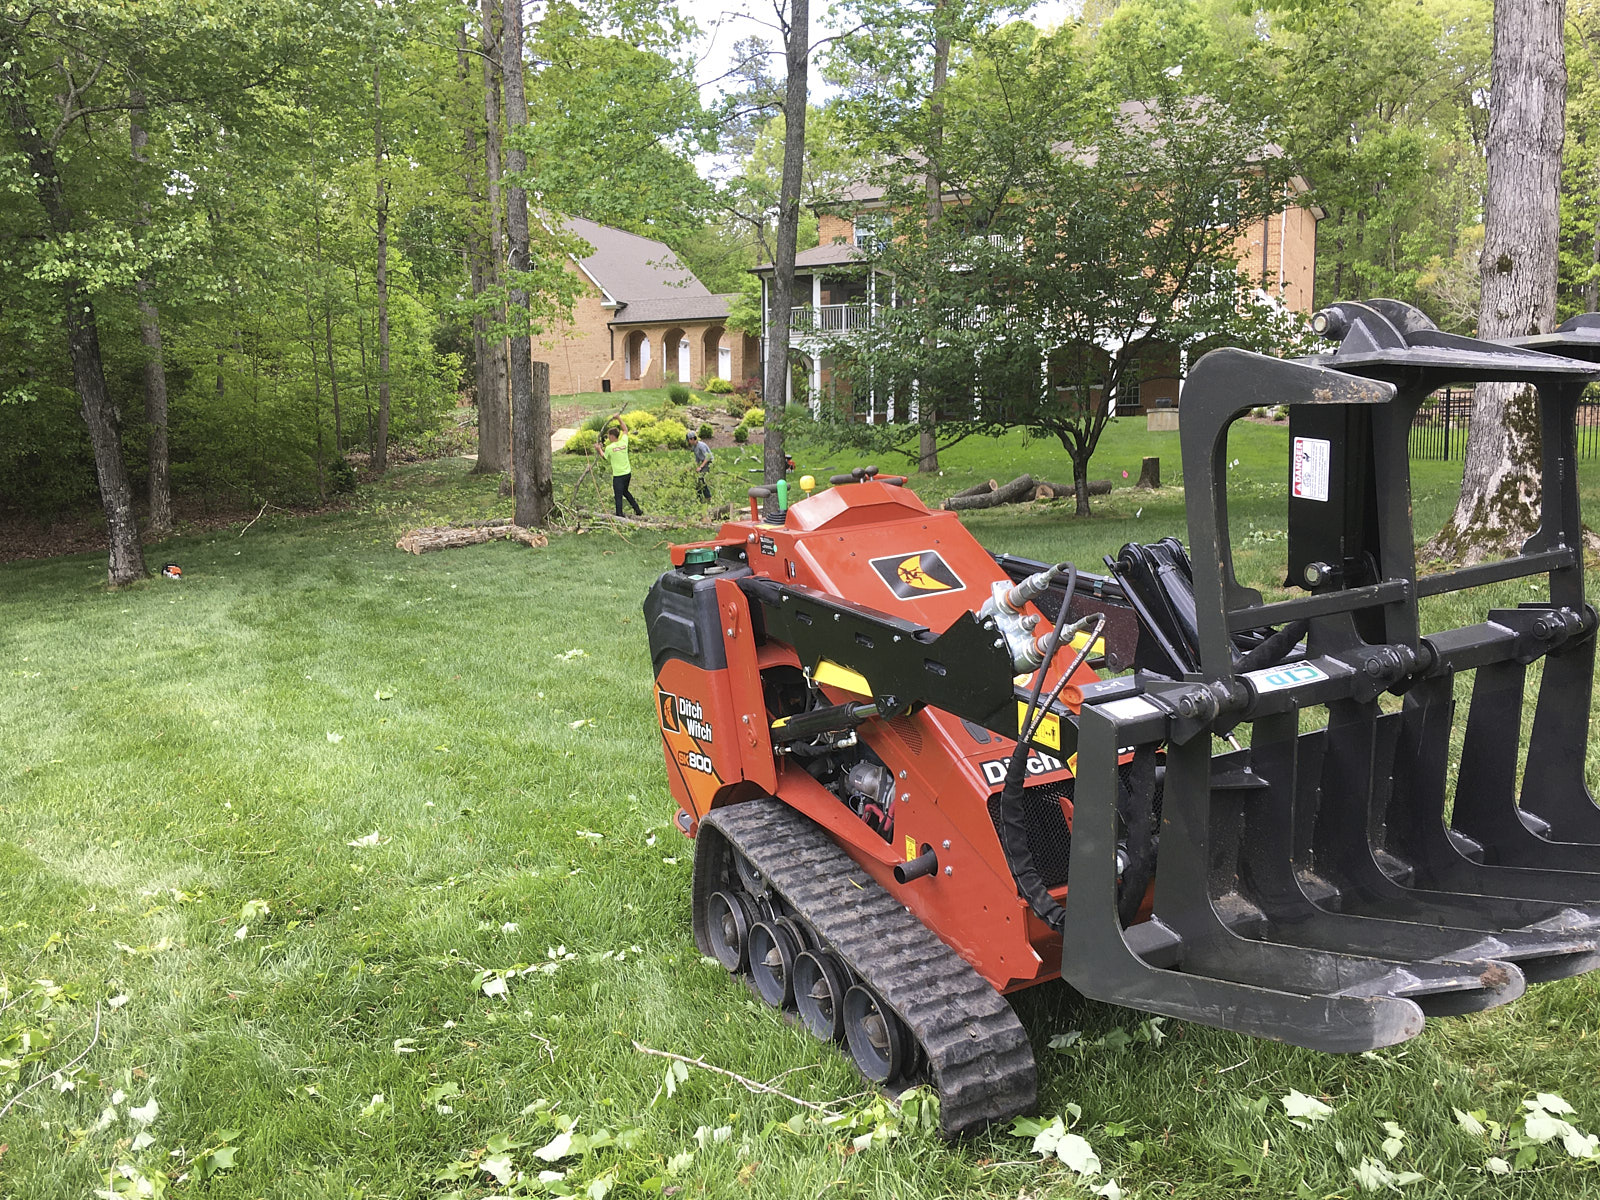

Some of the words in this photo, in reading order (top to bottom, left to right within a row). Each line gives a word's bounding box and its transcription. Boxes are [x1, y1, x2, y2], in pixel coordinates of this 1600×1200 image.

[1295, 442, 1303, 483] DANGER
[1265, 667, 1318, 685] CID
[679, 697, 703, 720] Ditch
[686, 718, 713, 742] Witch
[982, 750, 1061, 784] Dch
